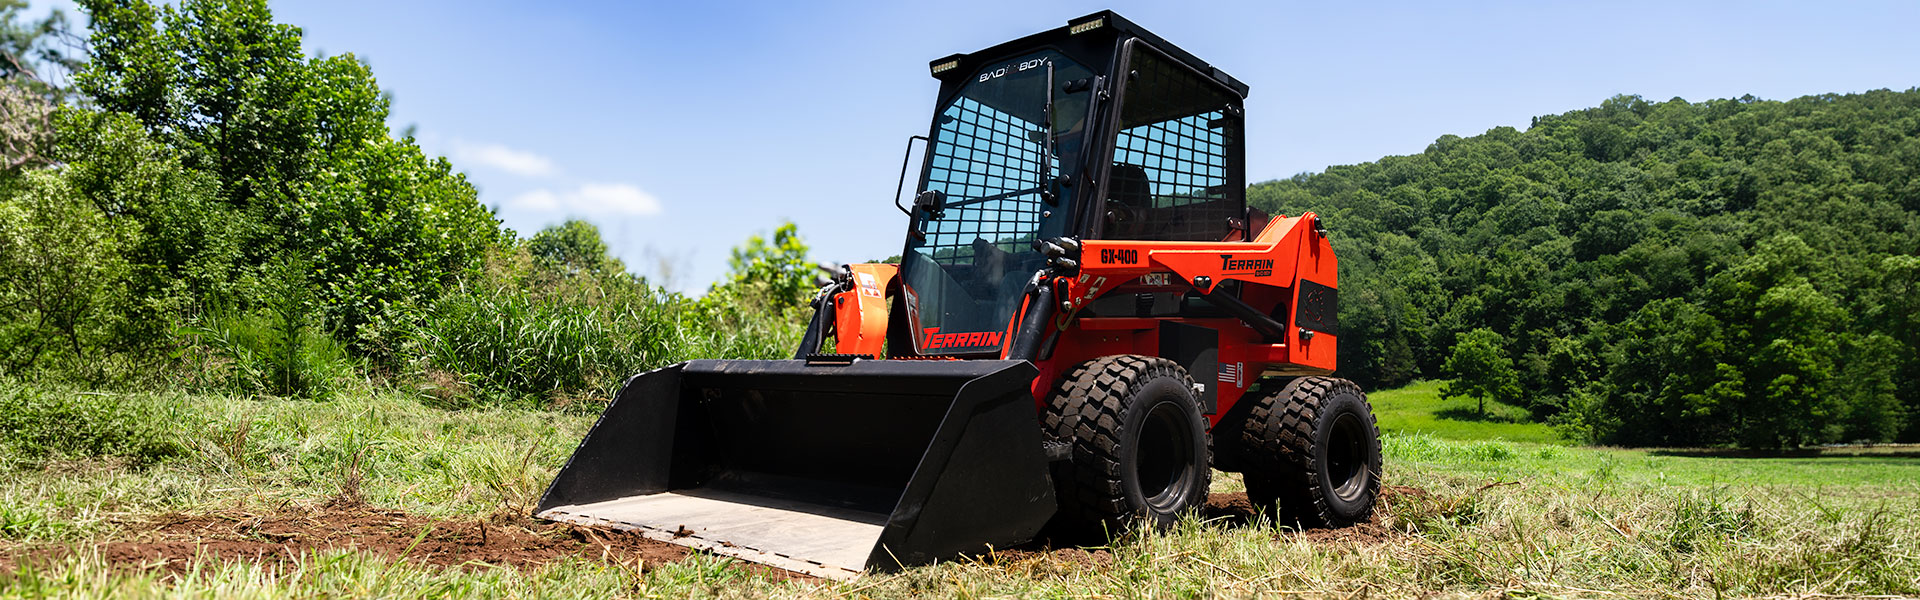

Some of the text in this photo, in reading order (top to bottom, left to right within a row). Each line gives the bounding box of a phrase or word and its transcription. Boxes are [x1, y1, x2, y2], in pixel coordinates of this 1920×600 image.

[979, 56, 1048, 83] BAD BOY
[1101, 248, 1138, 264] GX-400
[1219, 254, 1274, 270] TERRAIN
[921, 327, 1004, 349] TERRAIN
